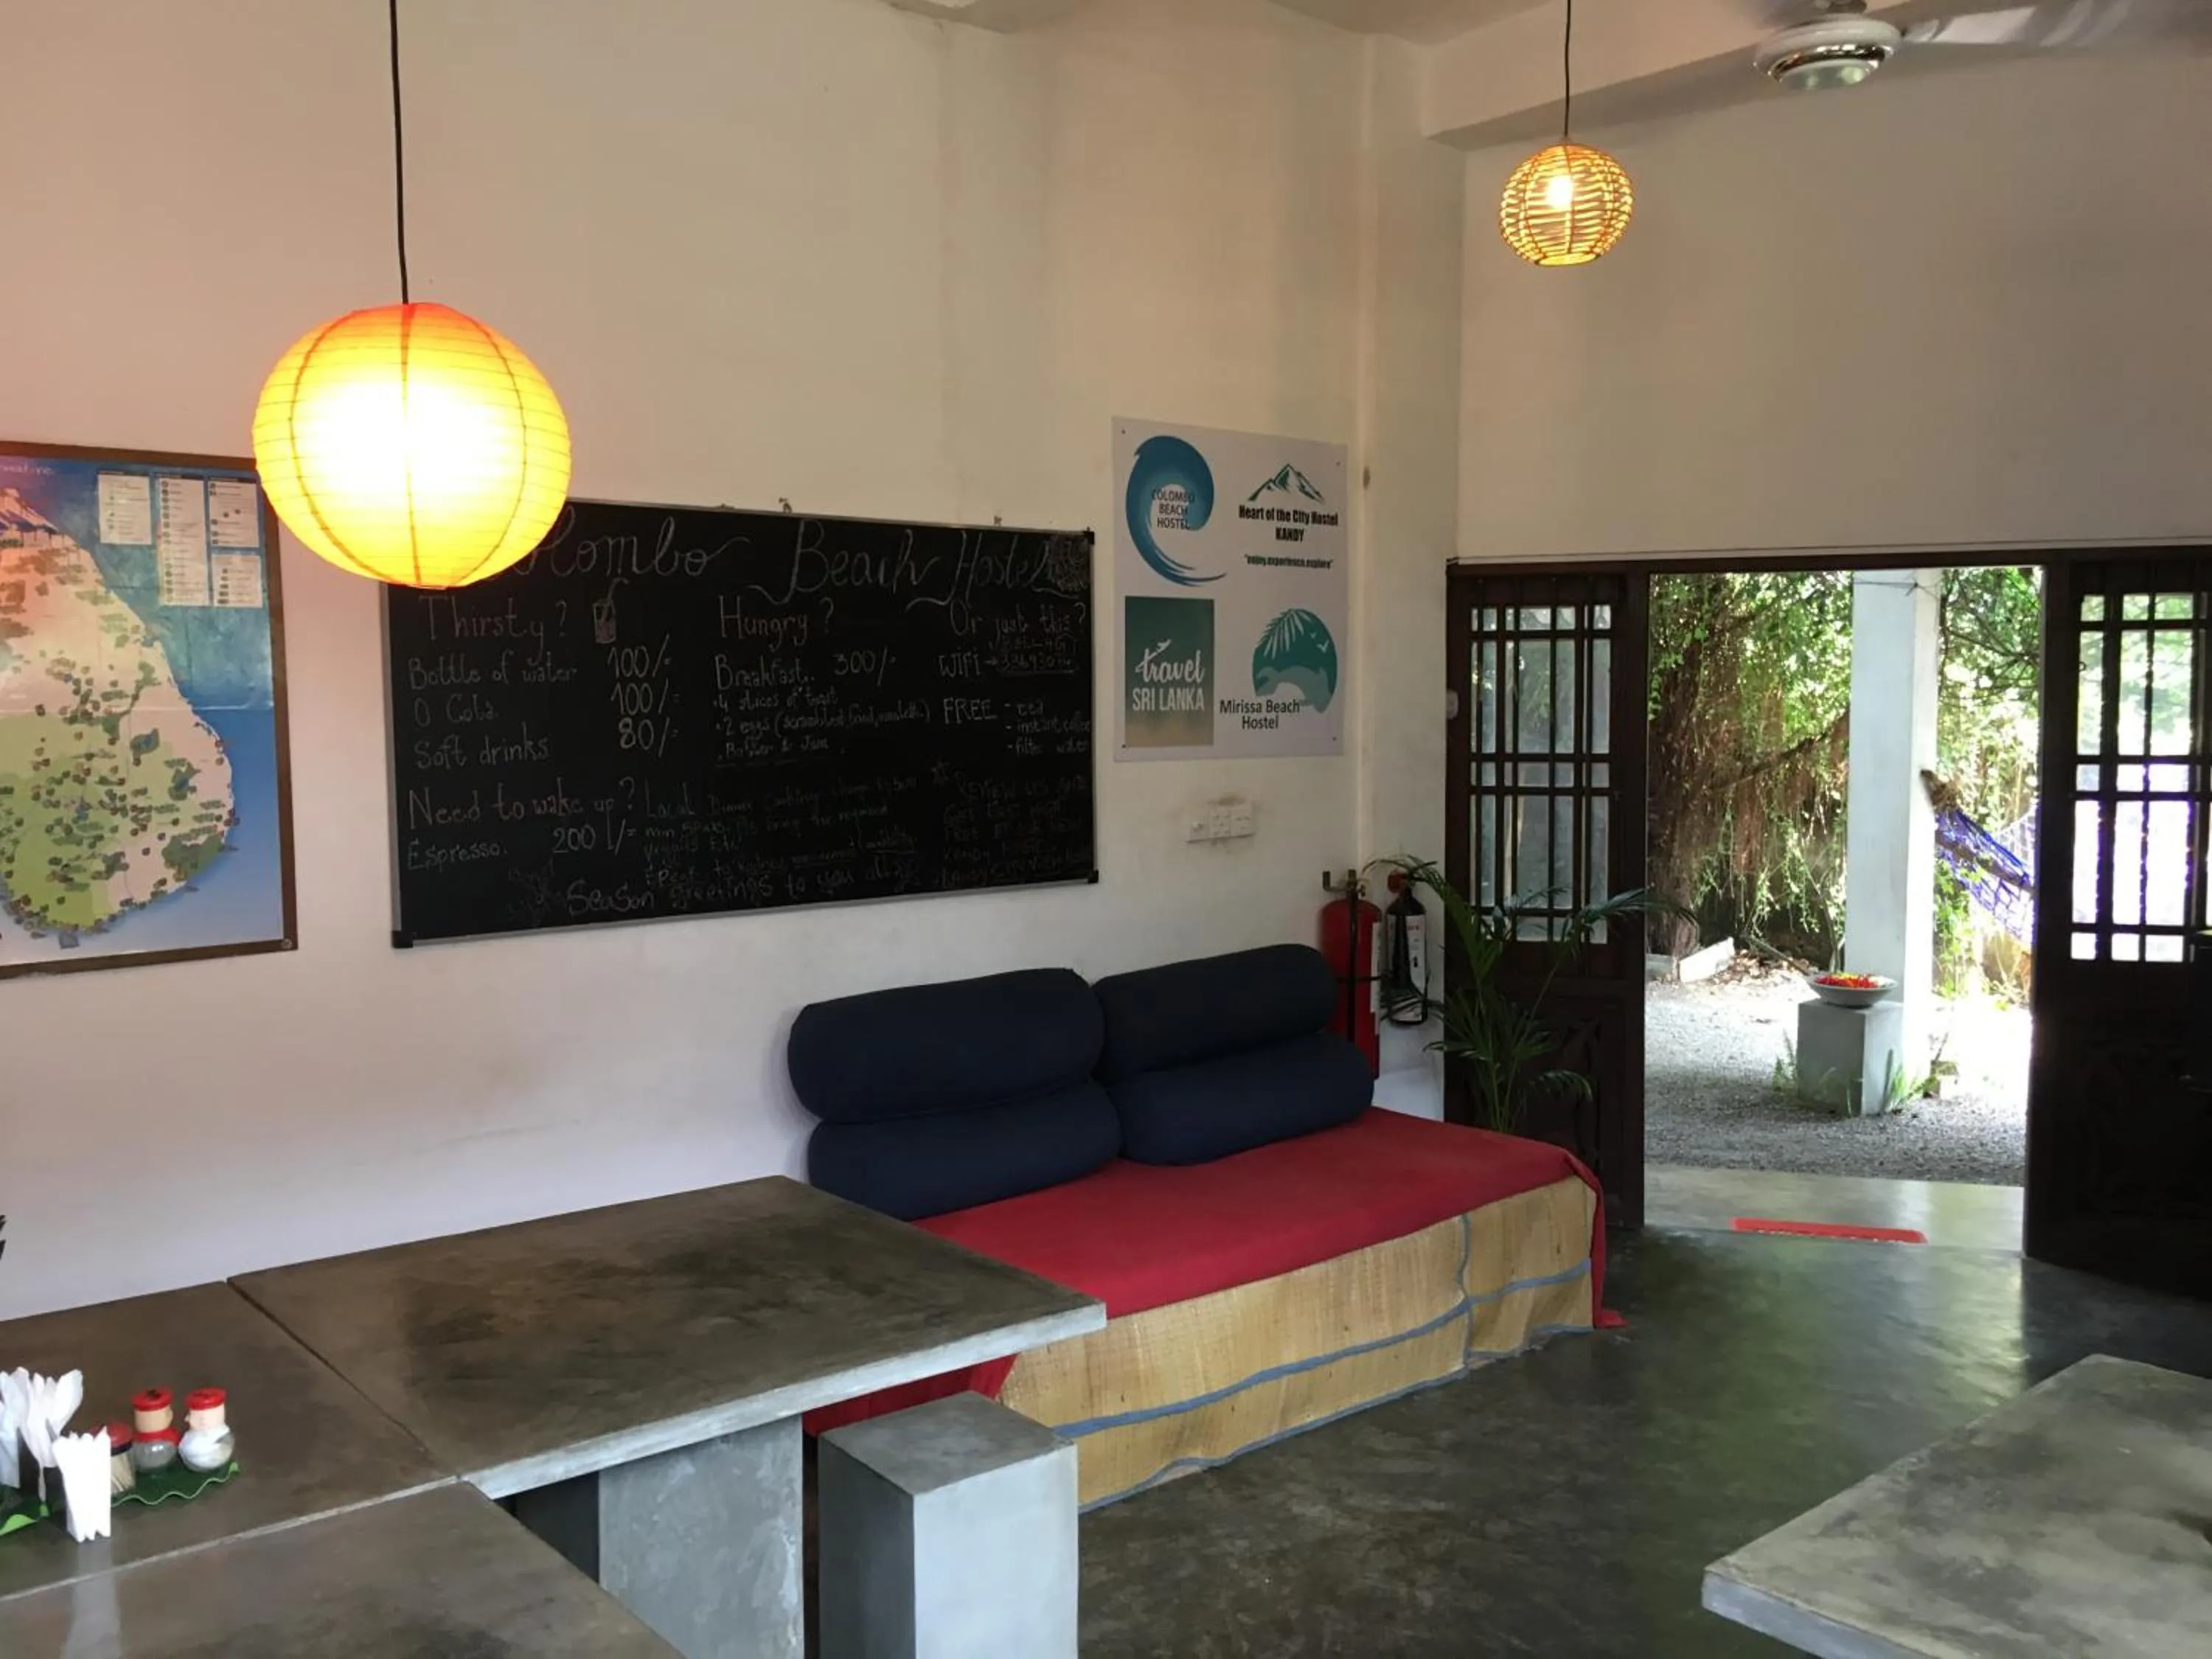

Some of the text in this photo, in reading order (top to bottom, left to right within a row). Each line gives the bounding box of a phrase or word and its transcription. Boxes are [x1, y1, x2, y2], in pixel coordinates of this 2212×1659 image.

[1151, 487, 1196, 503] COLOMBO
[1157, 517, 1191, 529] HOSTEL
[1158, 504, 1189, 516] BEACH
[1239, 505, 1338, 526] Heart of the City Hostel
[1275, 527, 1304, 542] KANDY
[515, 505, 749, 577] lombo
[746, 519, 940, 605] Beach
[950, 599, 984, 636] Or
[408, 652, 481, 689] Bottle
[493, 648, 515, 684] of
[521, 651, 577, 683] water
[1135, 647, 1206, 684] travel
[942, 698, 998, 725] FREE
[1132, 686, 1205, 712] SRI LANKA
[1220, 698, 1301, 714] Mirissa Beach
[1242, 715, 1279, 730] Hostel
[414, 734, 468, 770] Soft
[480, 720, 548, 766] drinks
[409, 787, 482, 830] Need
[491, 782, 525, 821] to
[532, 776, 585, 817] wake
